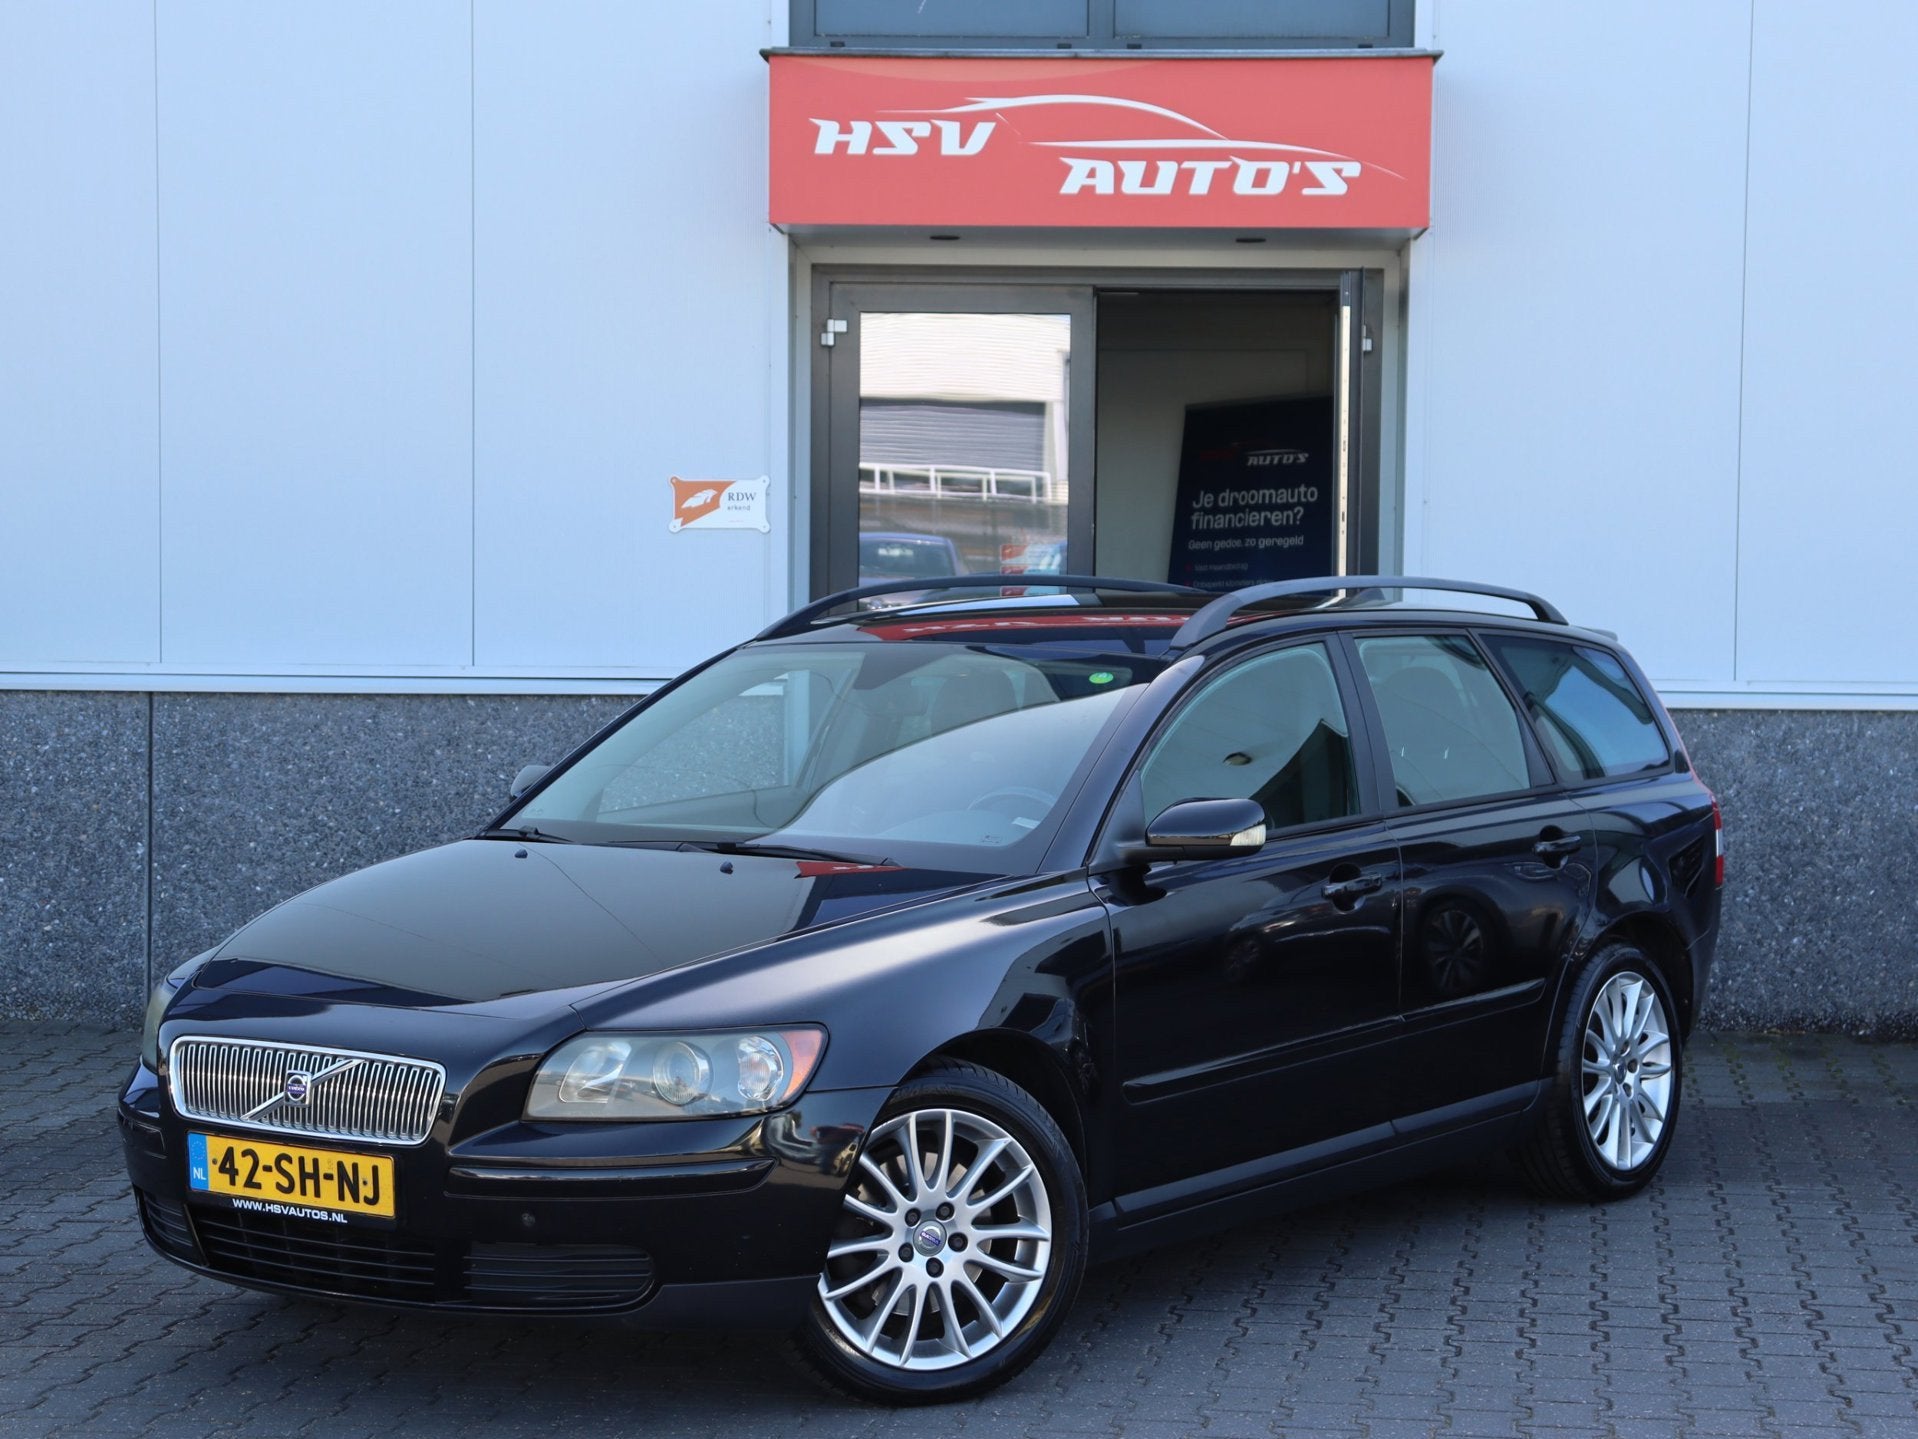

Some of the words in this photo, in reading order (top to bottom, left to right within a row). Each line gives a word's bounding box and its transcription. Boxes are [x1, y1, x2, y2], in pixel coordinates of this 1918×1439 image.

[809, 117, 996, 156] HSV
[1059, 155, 1361, 195] AUTO'S
[728, 491, 756, 502] RDW
[1192, 491, 1214, 508] Je
[1218, 484, 1318, 507] droomauto
[1191, 506, 1304, 530] financieren?
[1188, 539, 1213, 550] Geen
[1244, 538, 1257, 547] zo
[1258, 535, 1304, 549] geregeld
[193, 1167, 206, 1181] NL
[218, 1146, 380, 1206] 42-SH-NJ
[232, 1198, 348, 1223] WWW.HSVAUTOS.NL
